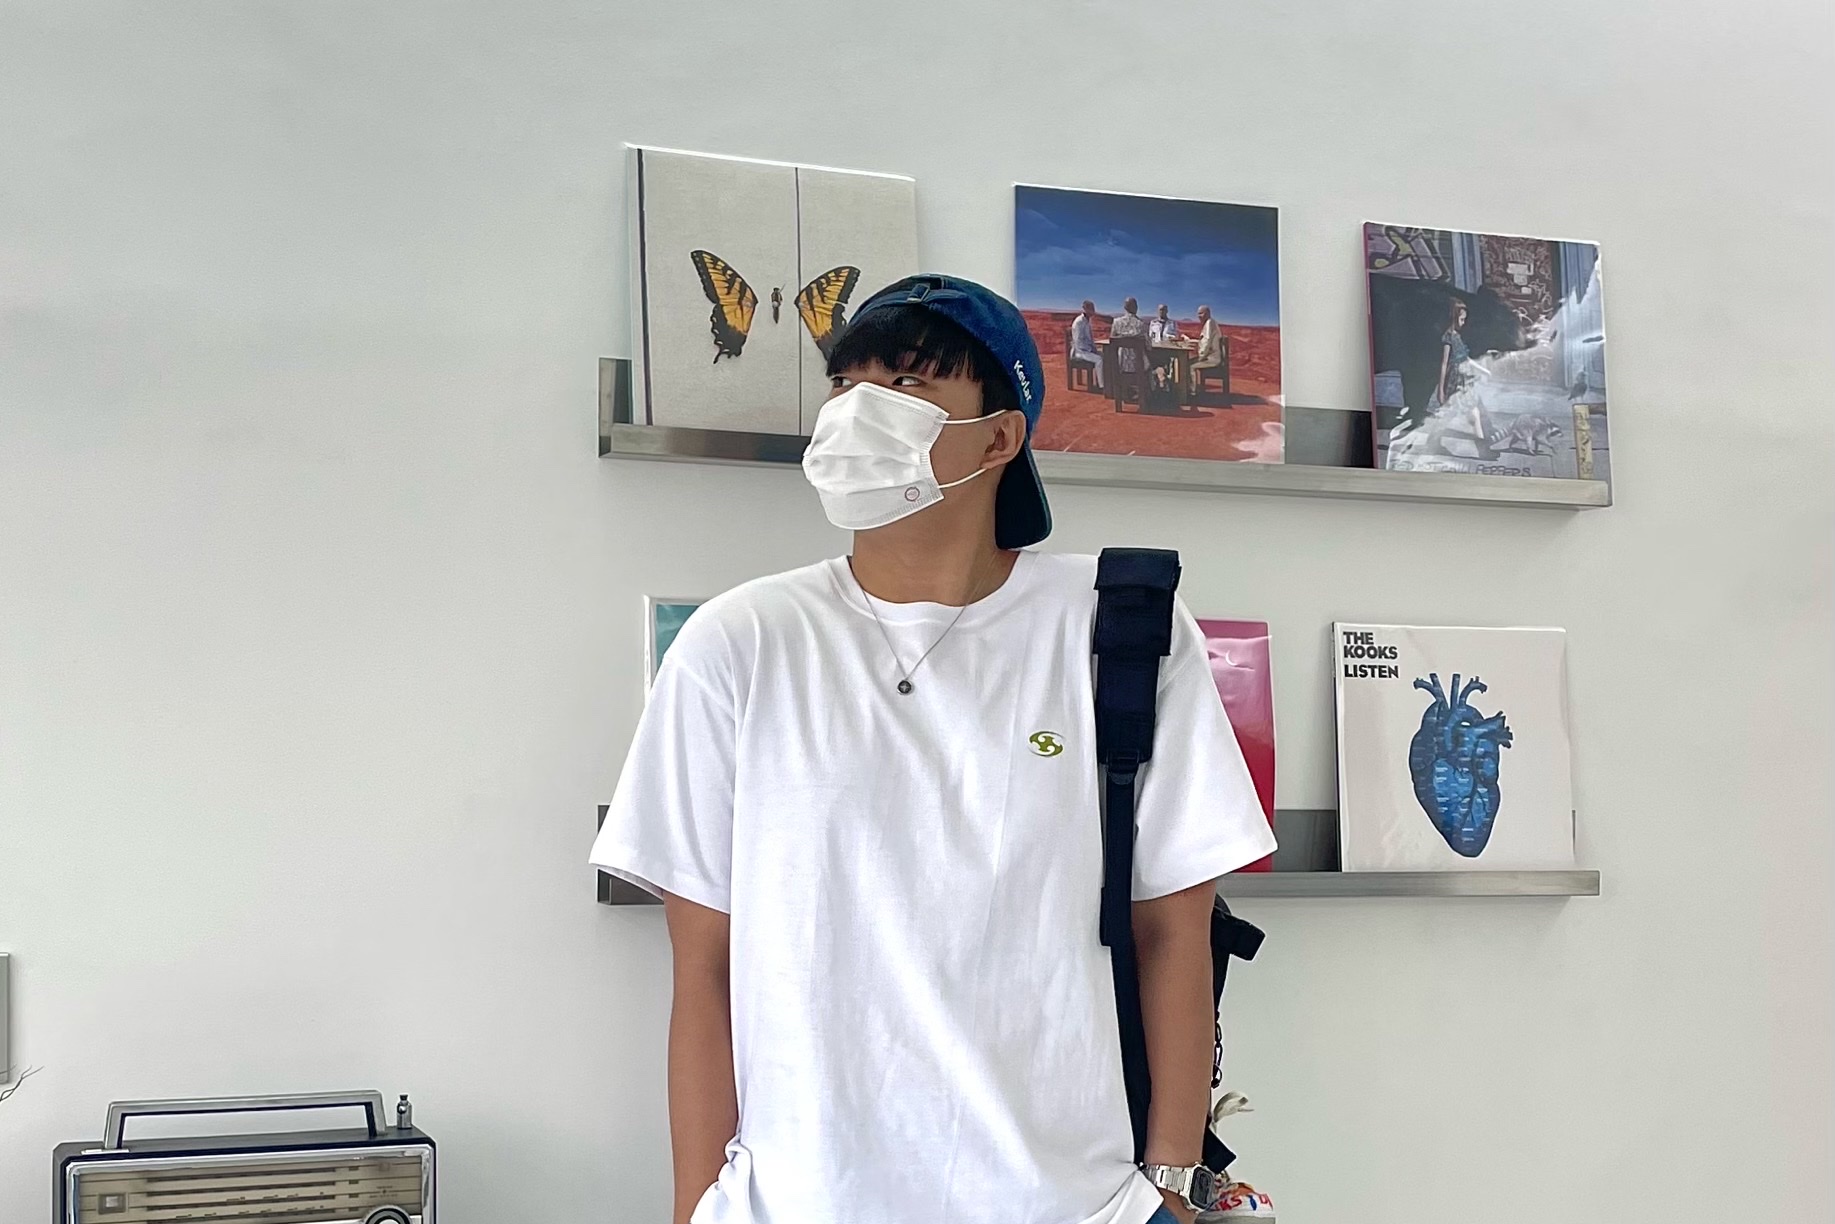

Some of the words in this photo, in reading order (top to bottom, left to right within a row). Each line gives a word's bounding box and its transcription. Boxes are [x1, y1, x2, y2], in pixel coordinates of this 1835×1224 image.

[1343, 631, 1374, 645] THE
[1344, 645, 1398, 660] KOOKS
[1344, 664, 1399, 679] LISTEN
